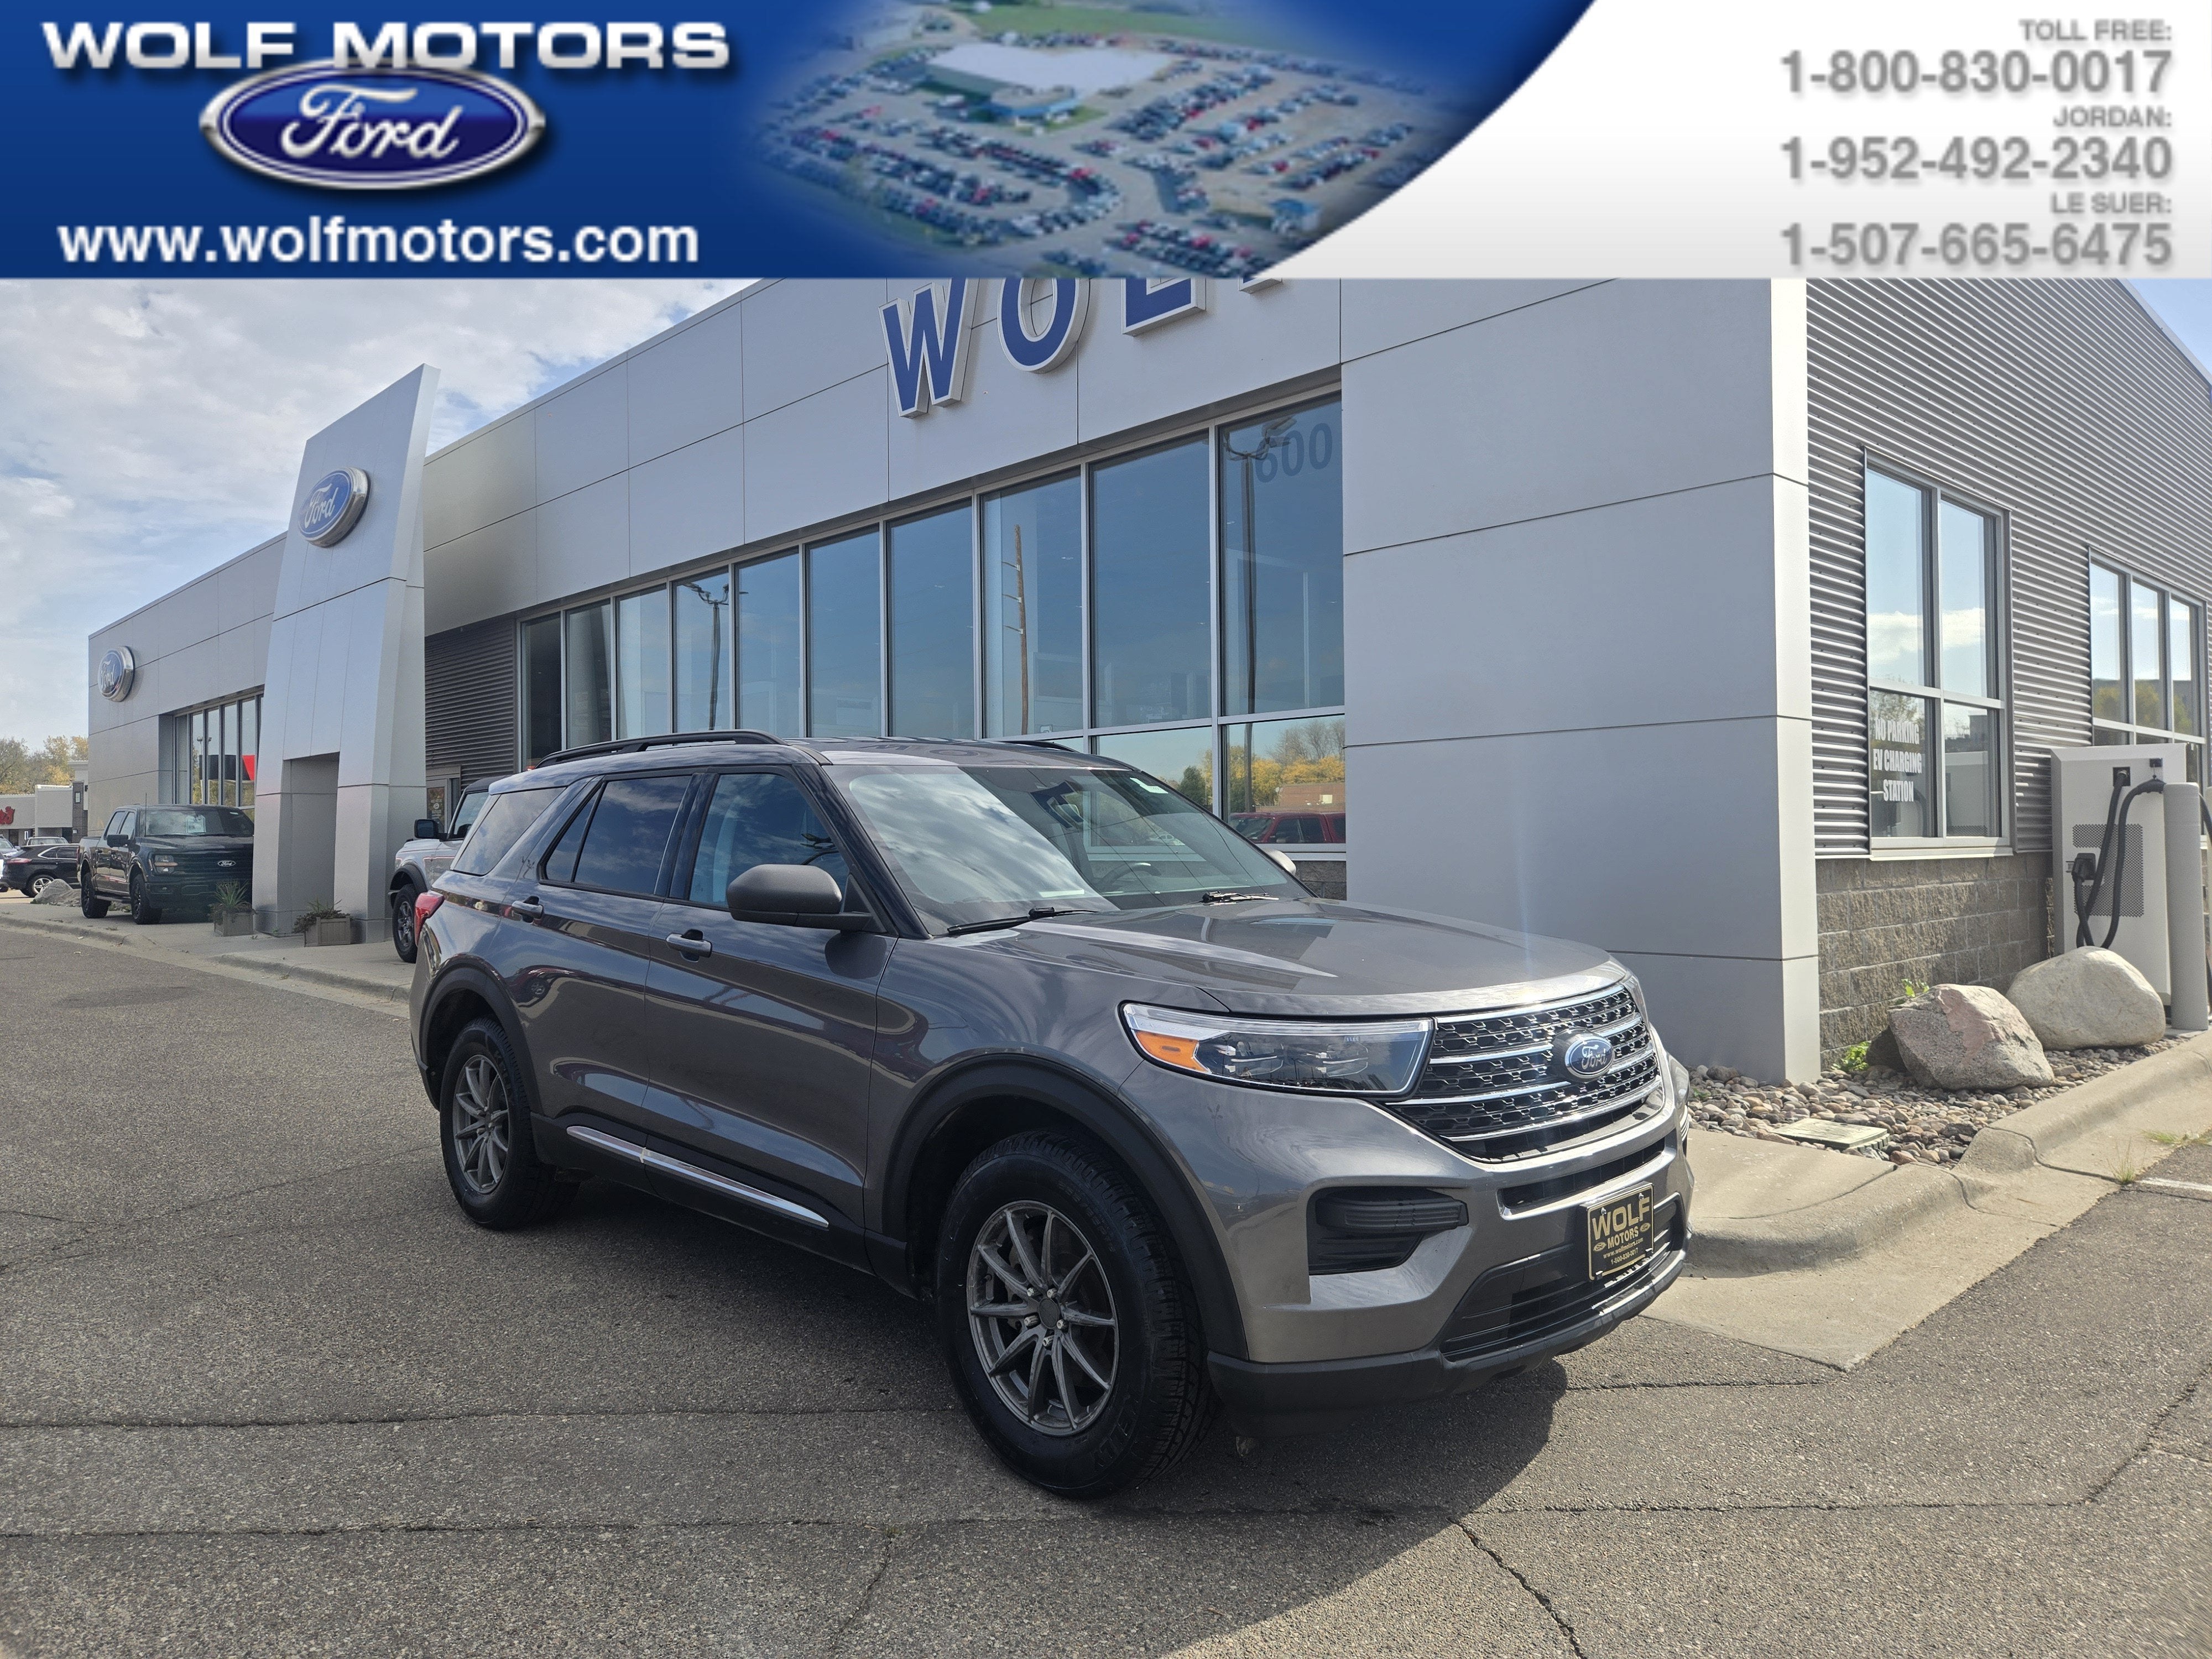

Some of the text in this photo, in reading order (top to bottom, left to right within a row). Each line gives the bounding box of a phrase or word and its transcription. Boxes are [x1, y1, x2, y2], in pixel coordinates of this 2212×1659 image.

[1255, 423, 1333, 483] 600
[304, 483, 339, 529] Ford
[1875, 719, 1919, 745] NO PARKING
[1873, 748, 1922, 774] EV CHARGING
[1883, 779, 1914, 802] STATION
[1581, 1044, 1607, 1070] Ford
[1592, 1196, 1650, 1240] WOLF
[1607, 1225, 1639, 1249] MOTORS
